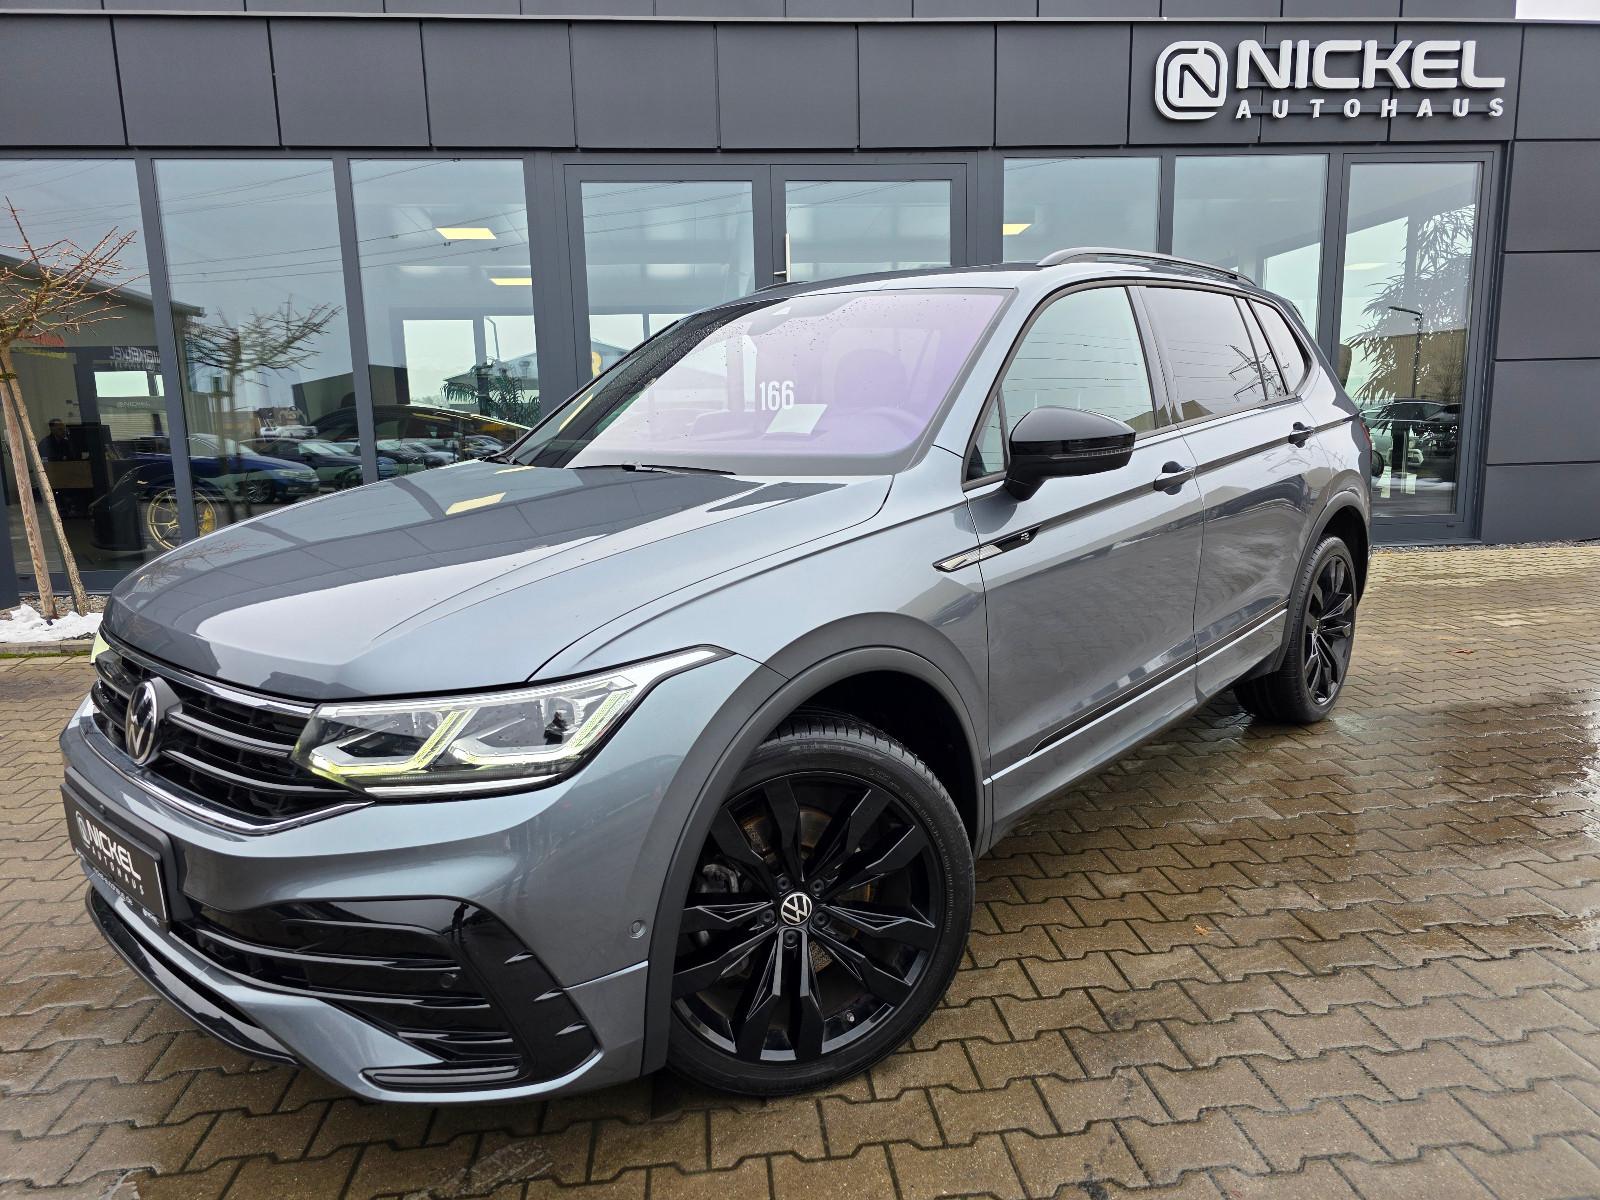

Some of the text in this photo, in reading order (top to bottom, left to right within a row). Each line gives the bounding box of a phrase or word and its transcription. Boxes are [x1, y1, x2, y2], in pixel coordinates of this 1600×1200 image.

[1236, 40, 1506, 89] NICKEL
[1235, 97, 1504, 119] AUTOHAUS
[759, 380, 795, 411] 166
[85, 819, 142, 881] NICKEL
[92, 845, 145, 896] AUTOHAUS
